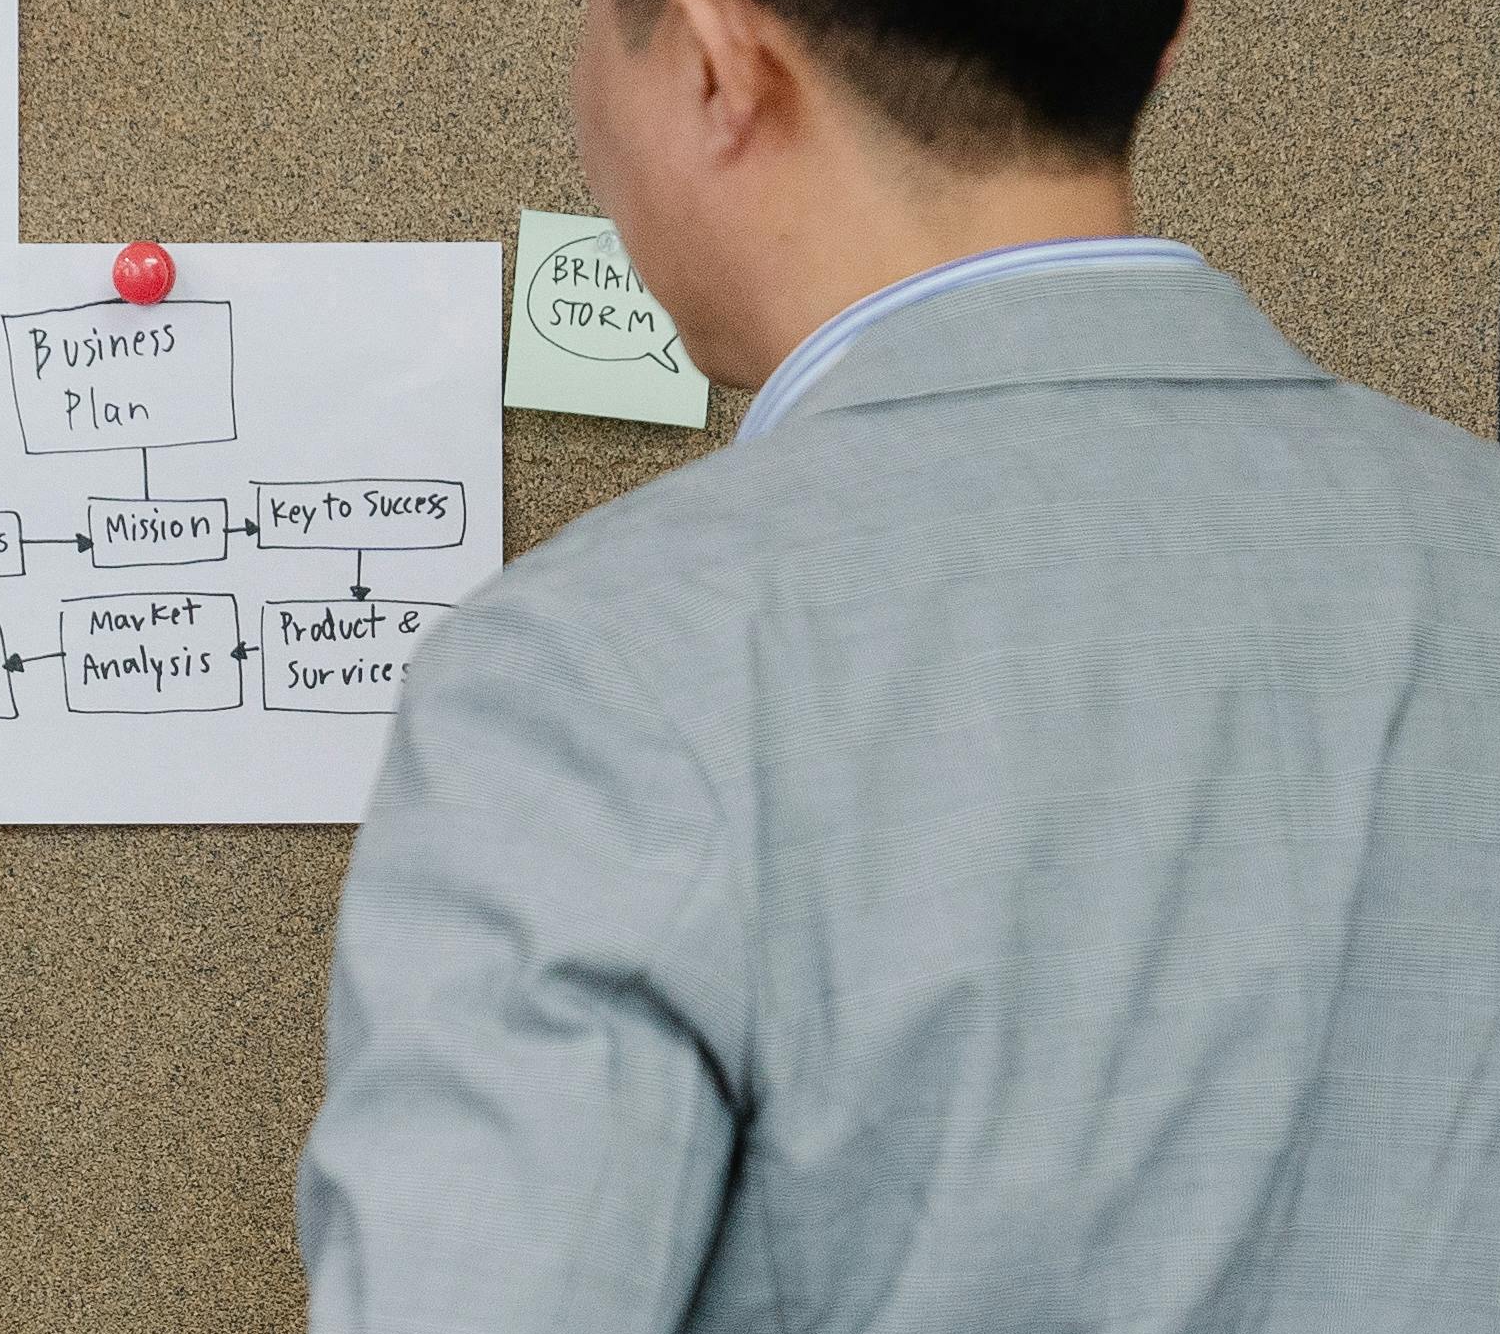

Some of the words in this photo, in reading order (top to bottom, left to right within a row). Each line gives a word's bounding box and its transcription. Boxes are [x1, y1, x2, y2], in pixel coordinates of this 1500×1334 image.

[549, 298, 656, 333] STORM
[28, 323, 176, 380] Business
[64, 386, 150, 431] Plan
[322, 491, 353, 521] to
[362, 489, 450, 520] Success
[105, 507, 212, 545] Mission
[89, 597, 203, 636] Market
[279, 602, 388, 646] Product
[397, 609, 422, 635] &
[82, 643, 212, 693] Analysis
